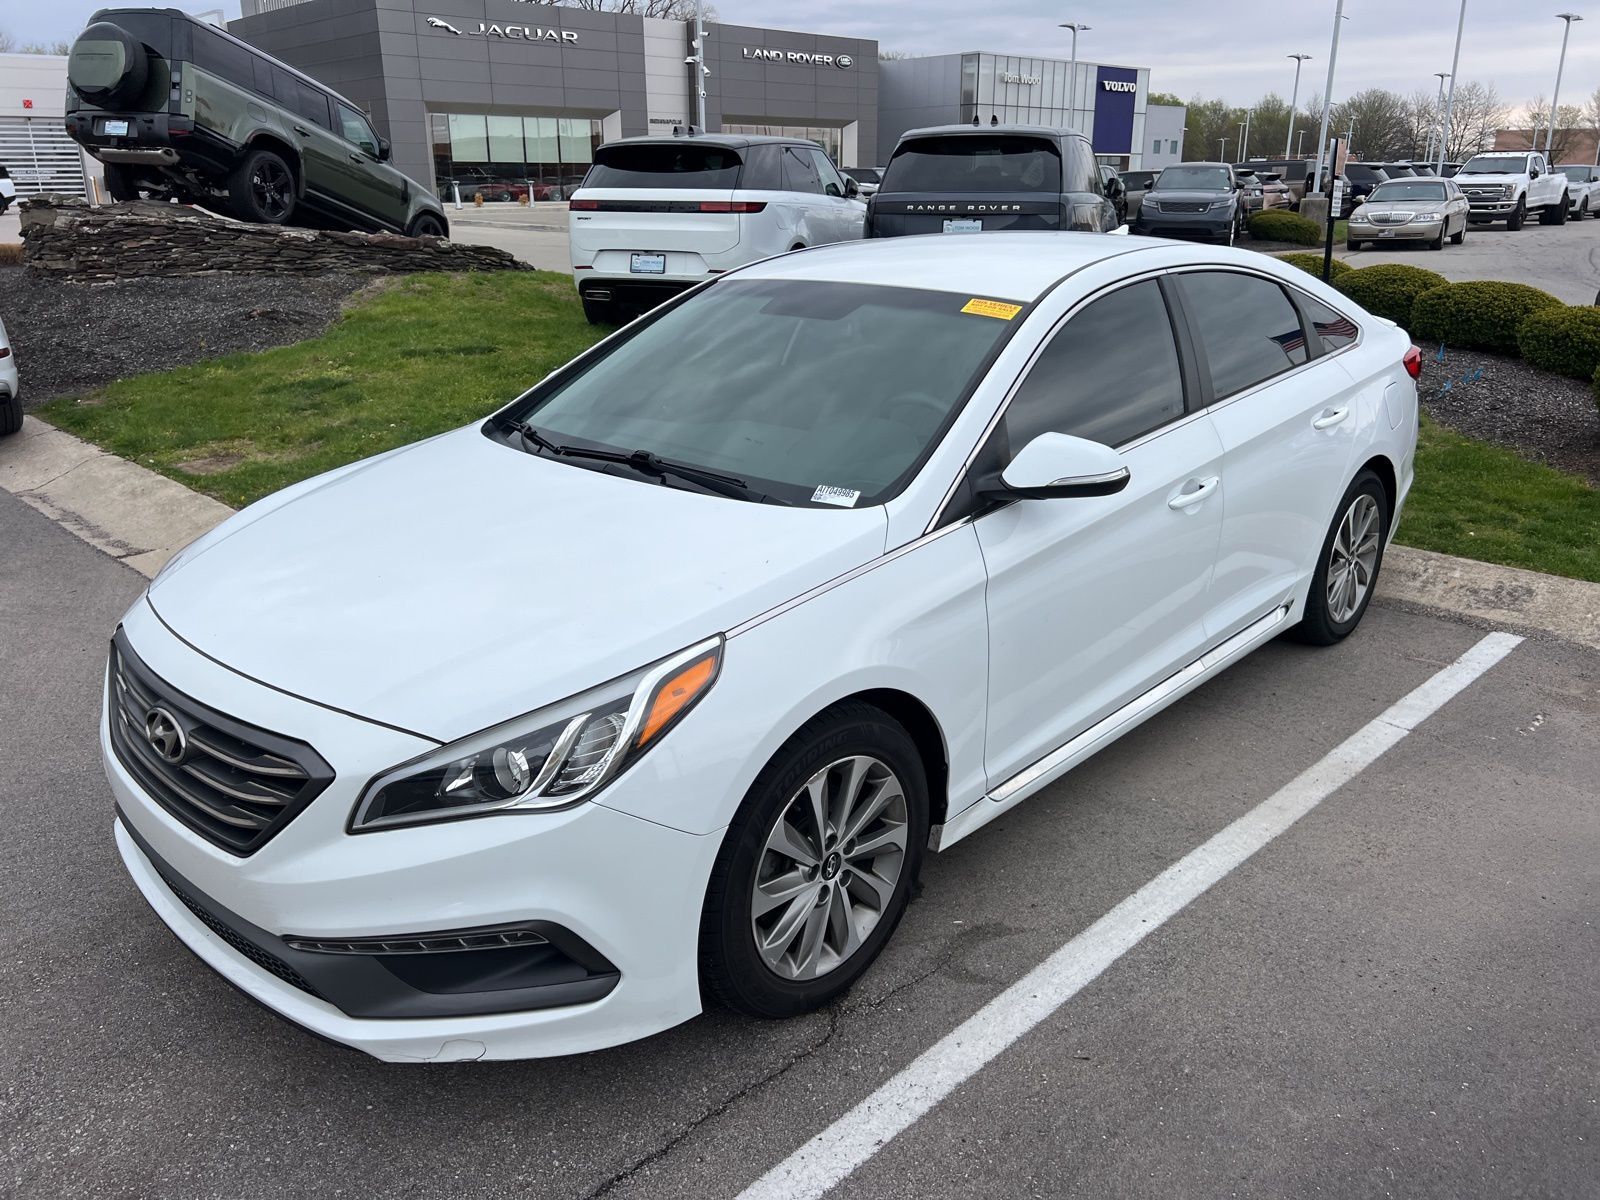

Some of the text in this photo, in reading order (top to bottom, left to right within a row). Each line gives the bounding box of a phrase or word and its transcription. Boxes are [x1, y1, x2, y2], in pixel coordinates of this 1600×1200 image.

[468, 23, 578, 44] JAGUAR
[743, 48, 783, 61] LAND
[786, 51, 833, 66] ROVER
[1003, 71, 1020, 84] Tom
[1103, 80, 1137, 93] VOLVO
